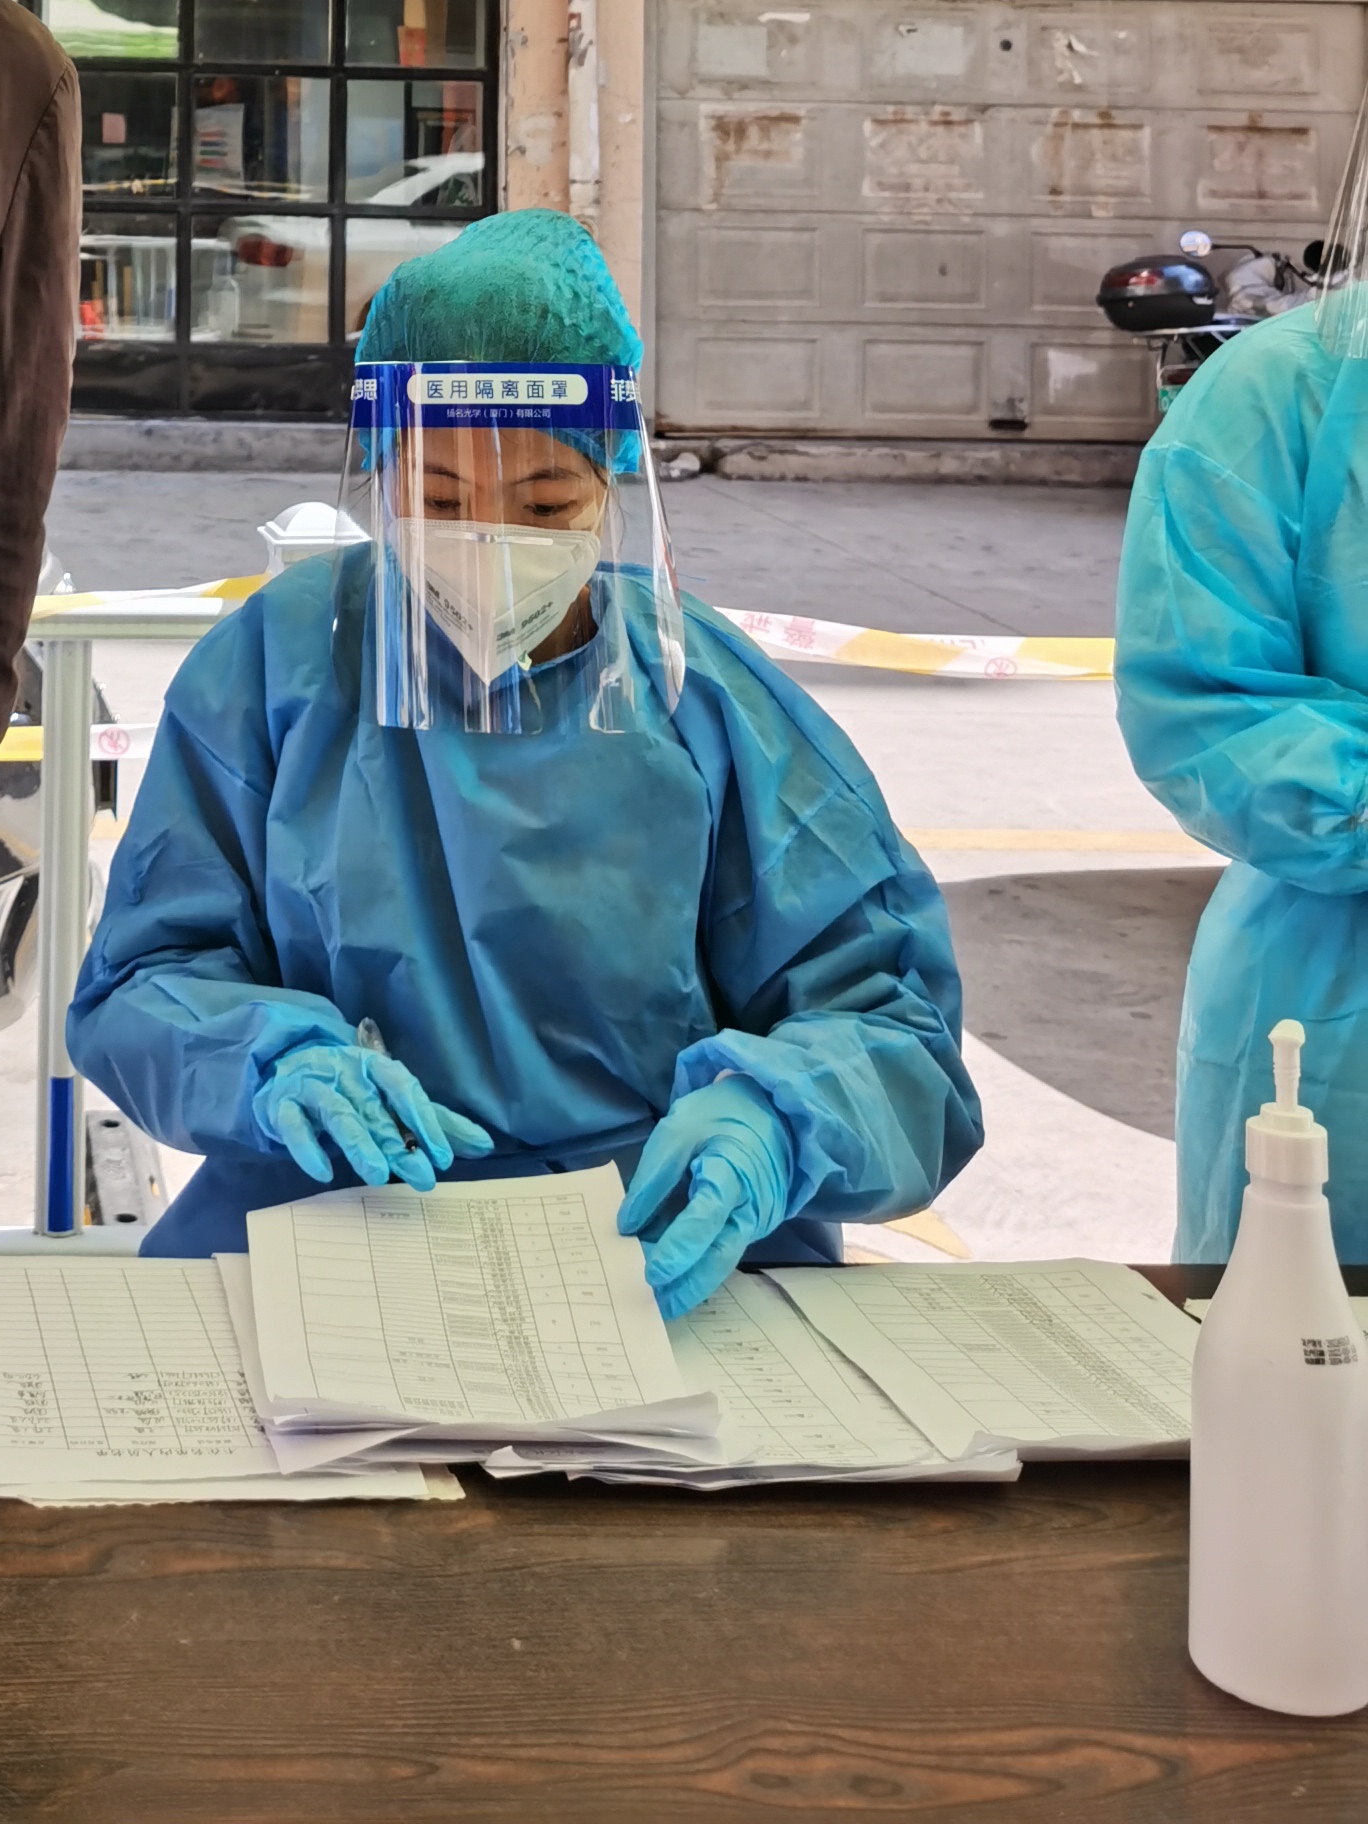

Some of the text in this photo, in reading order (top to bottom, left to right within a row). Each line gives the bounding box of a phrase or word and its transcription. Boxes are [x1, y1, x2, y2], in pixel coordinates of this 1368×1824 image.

[427, 379, 569, 400] 医用隔离面罩
